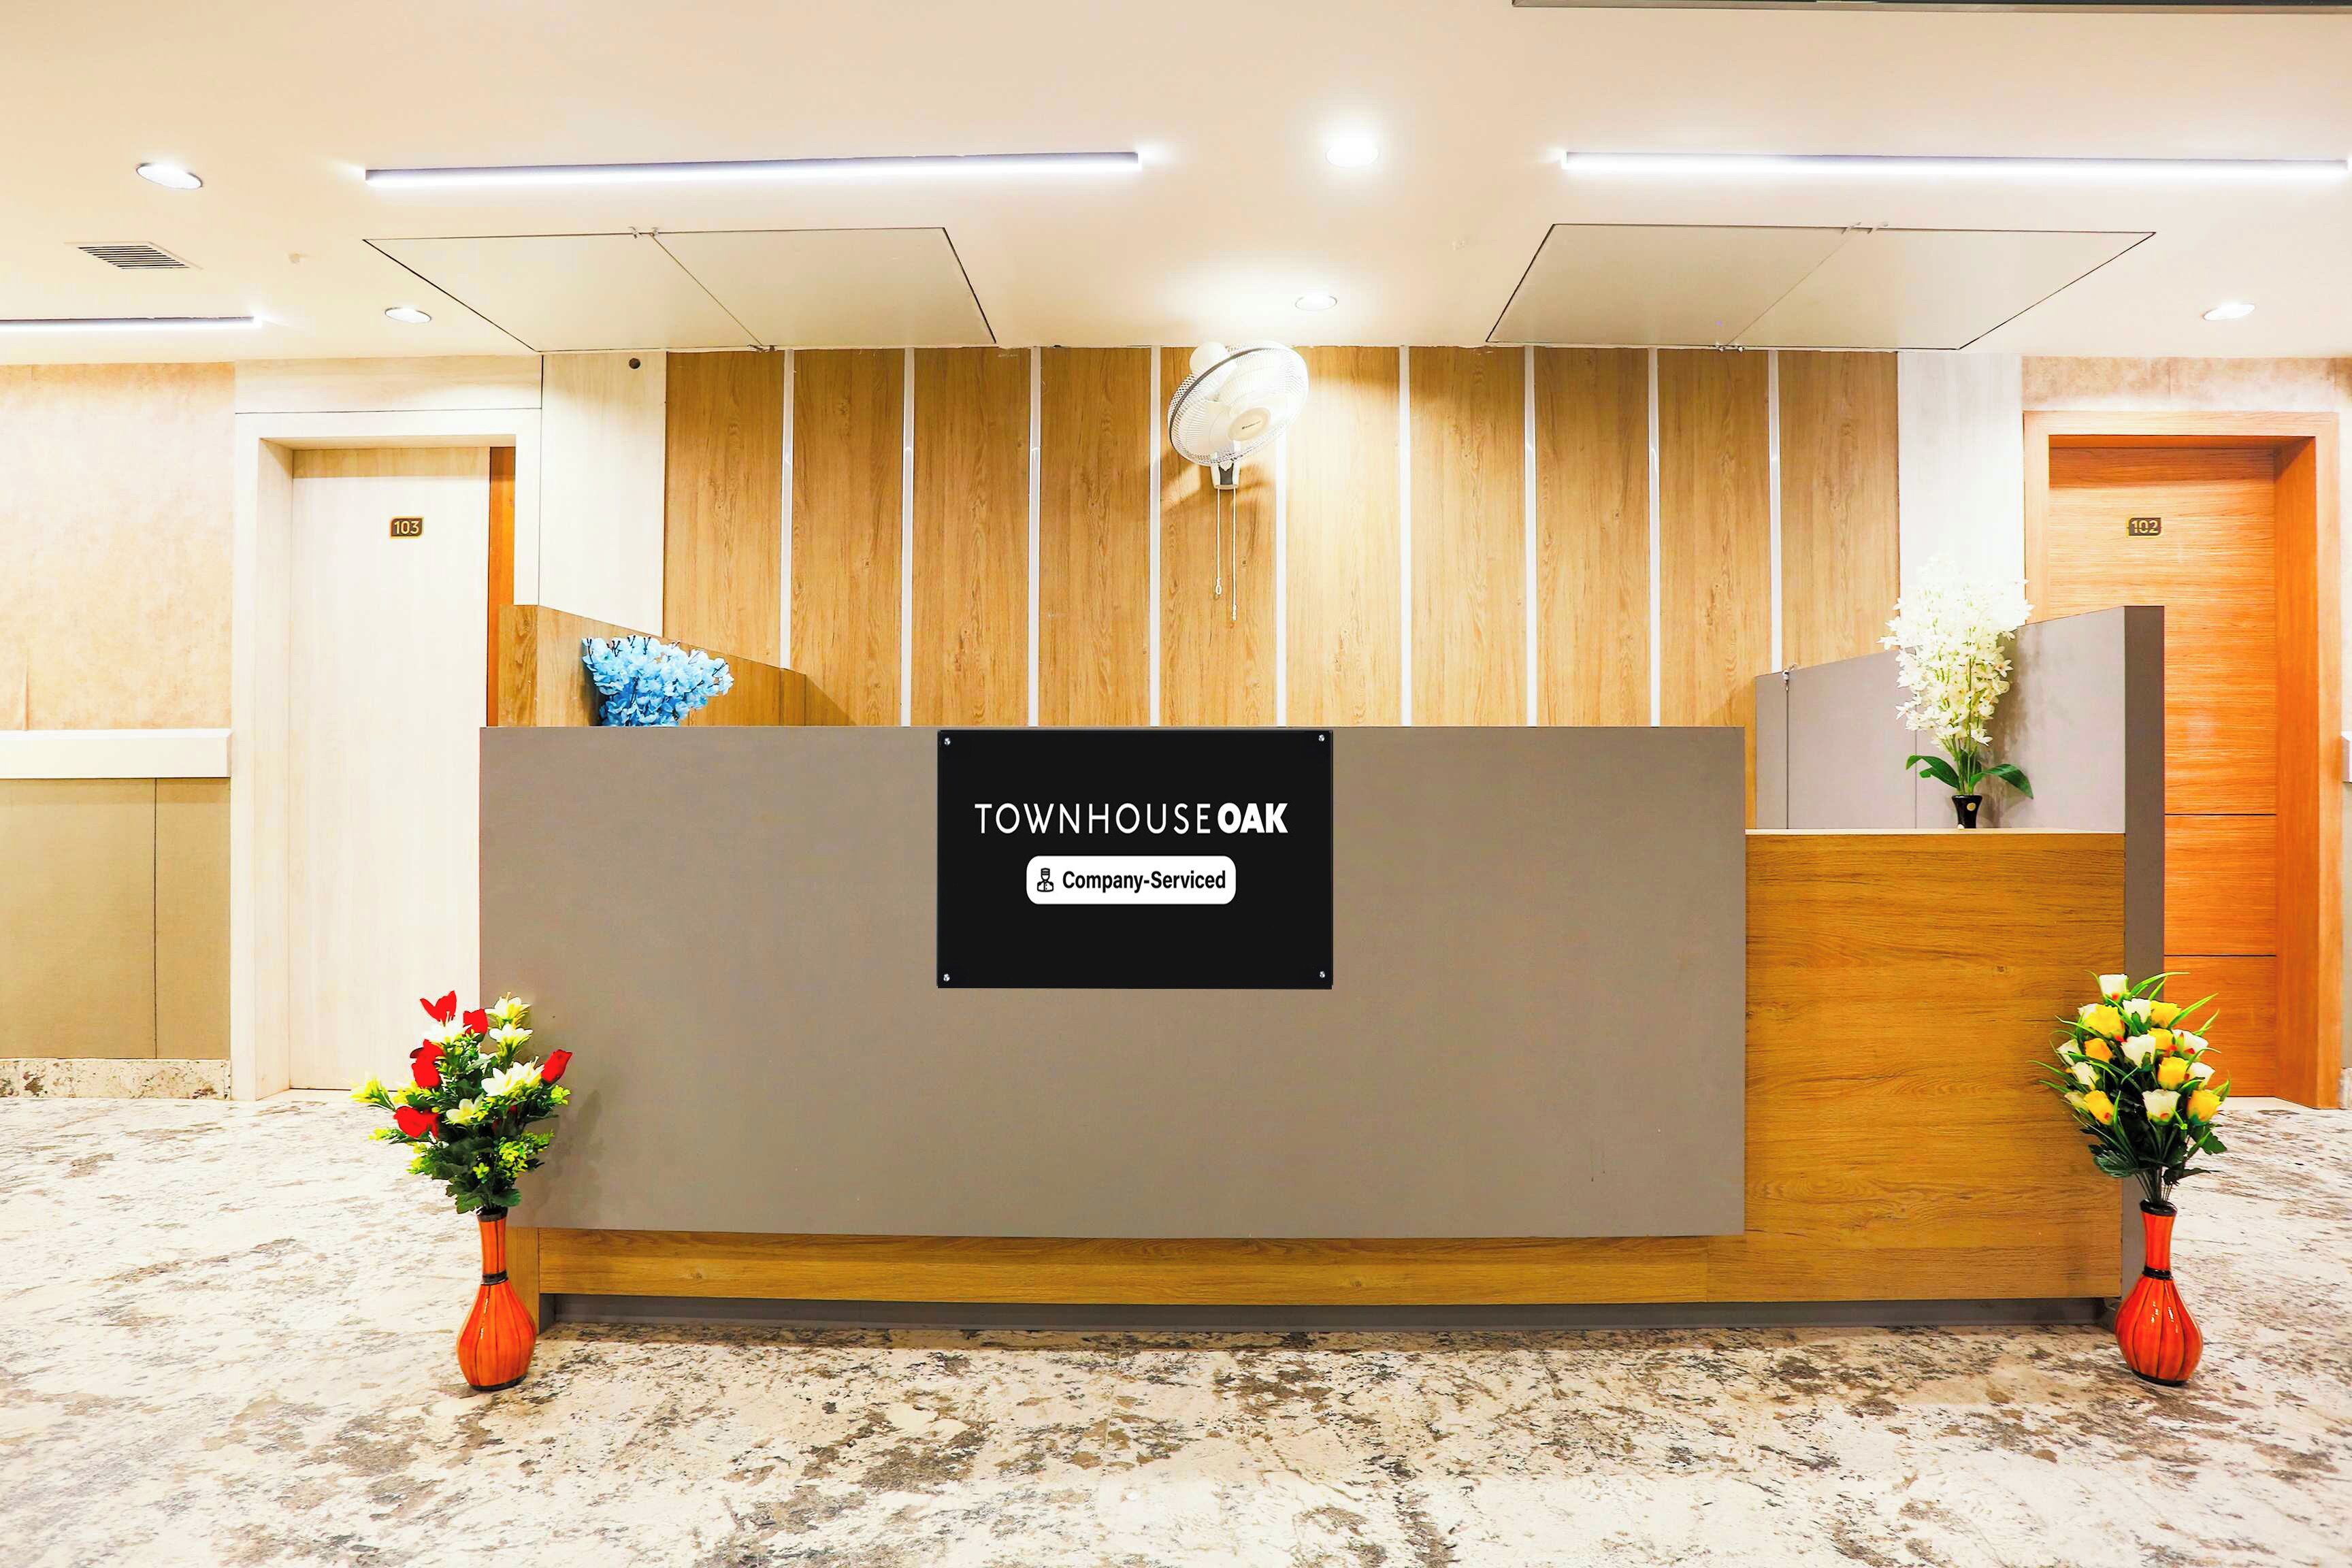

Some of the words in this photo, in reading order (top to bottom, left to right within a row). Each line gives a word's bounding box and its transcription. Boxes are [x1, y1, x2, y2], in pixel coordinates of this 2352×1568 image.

[395, 521, 419, 534] 103
[2132, 520, 2158, 534] 102
[974, 802, 1211, 834] TOWNHOUSE
[1217, 802, 1288, 834] OAK
[1062, 870, 1226, 894] Company-Serviced
